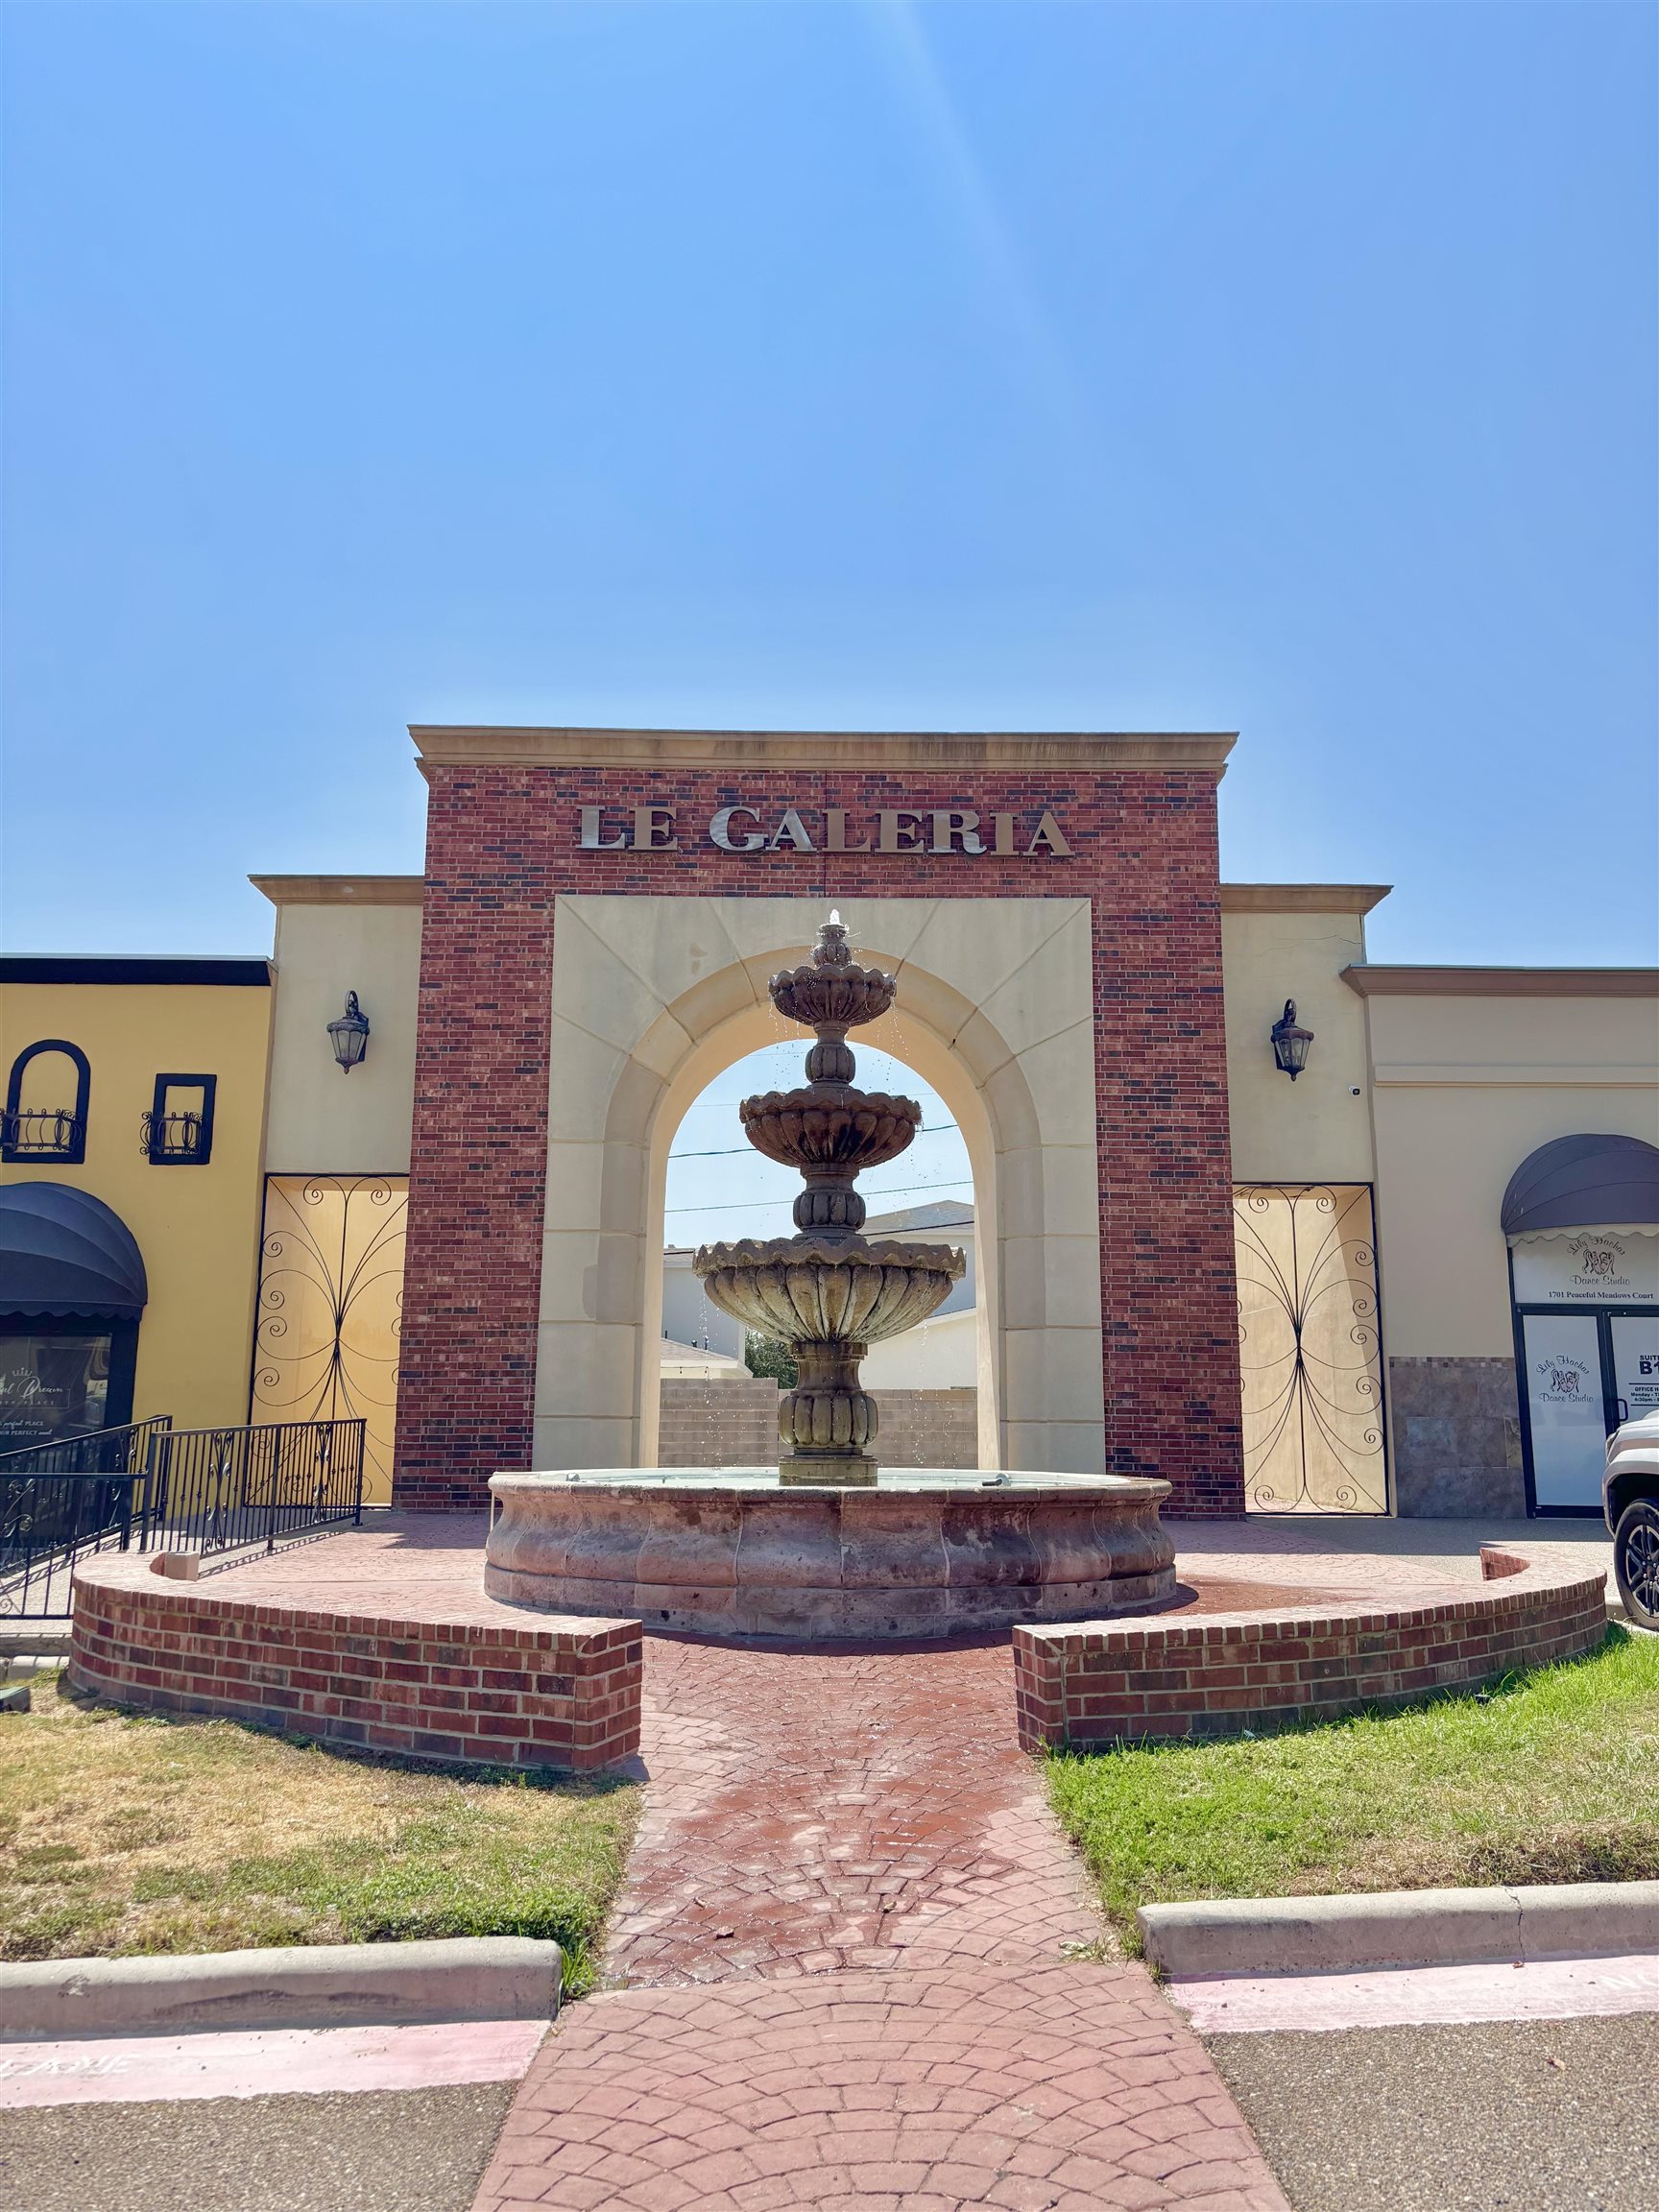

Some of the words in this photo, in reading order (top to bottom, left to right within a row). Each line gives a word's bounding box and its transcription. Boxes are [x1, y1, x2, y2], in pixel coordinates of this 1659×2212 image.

[576, 805, 678, 851] LE
[709, 806, 1074, 857] GALERIA
[1567, 1238, 1589, 1255] Lily
[1570, 1274, 1599, 1286] Dance
[1602, 1274, 1630, 1286] Studio
[1536, 1359, 1556, 1374] Lily
[1539, 1392, 1566, 1402] Dance
[1568, 1392, 1594, 1403] Studio
